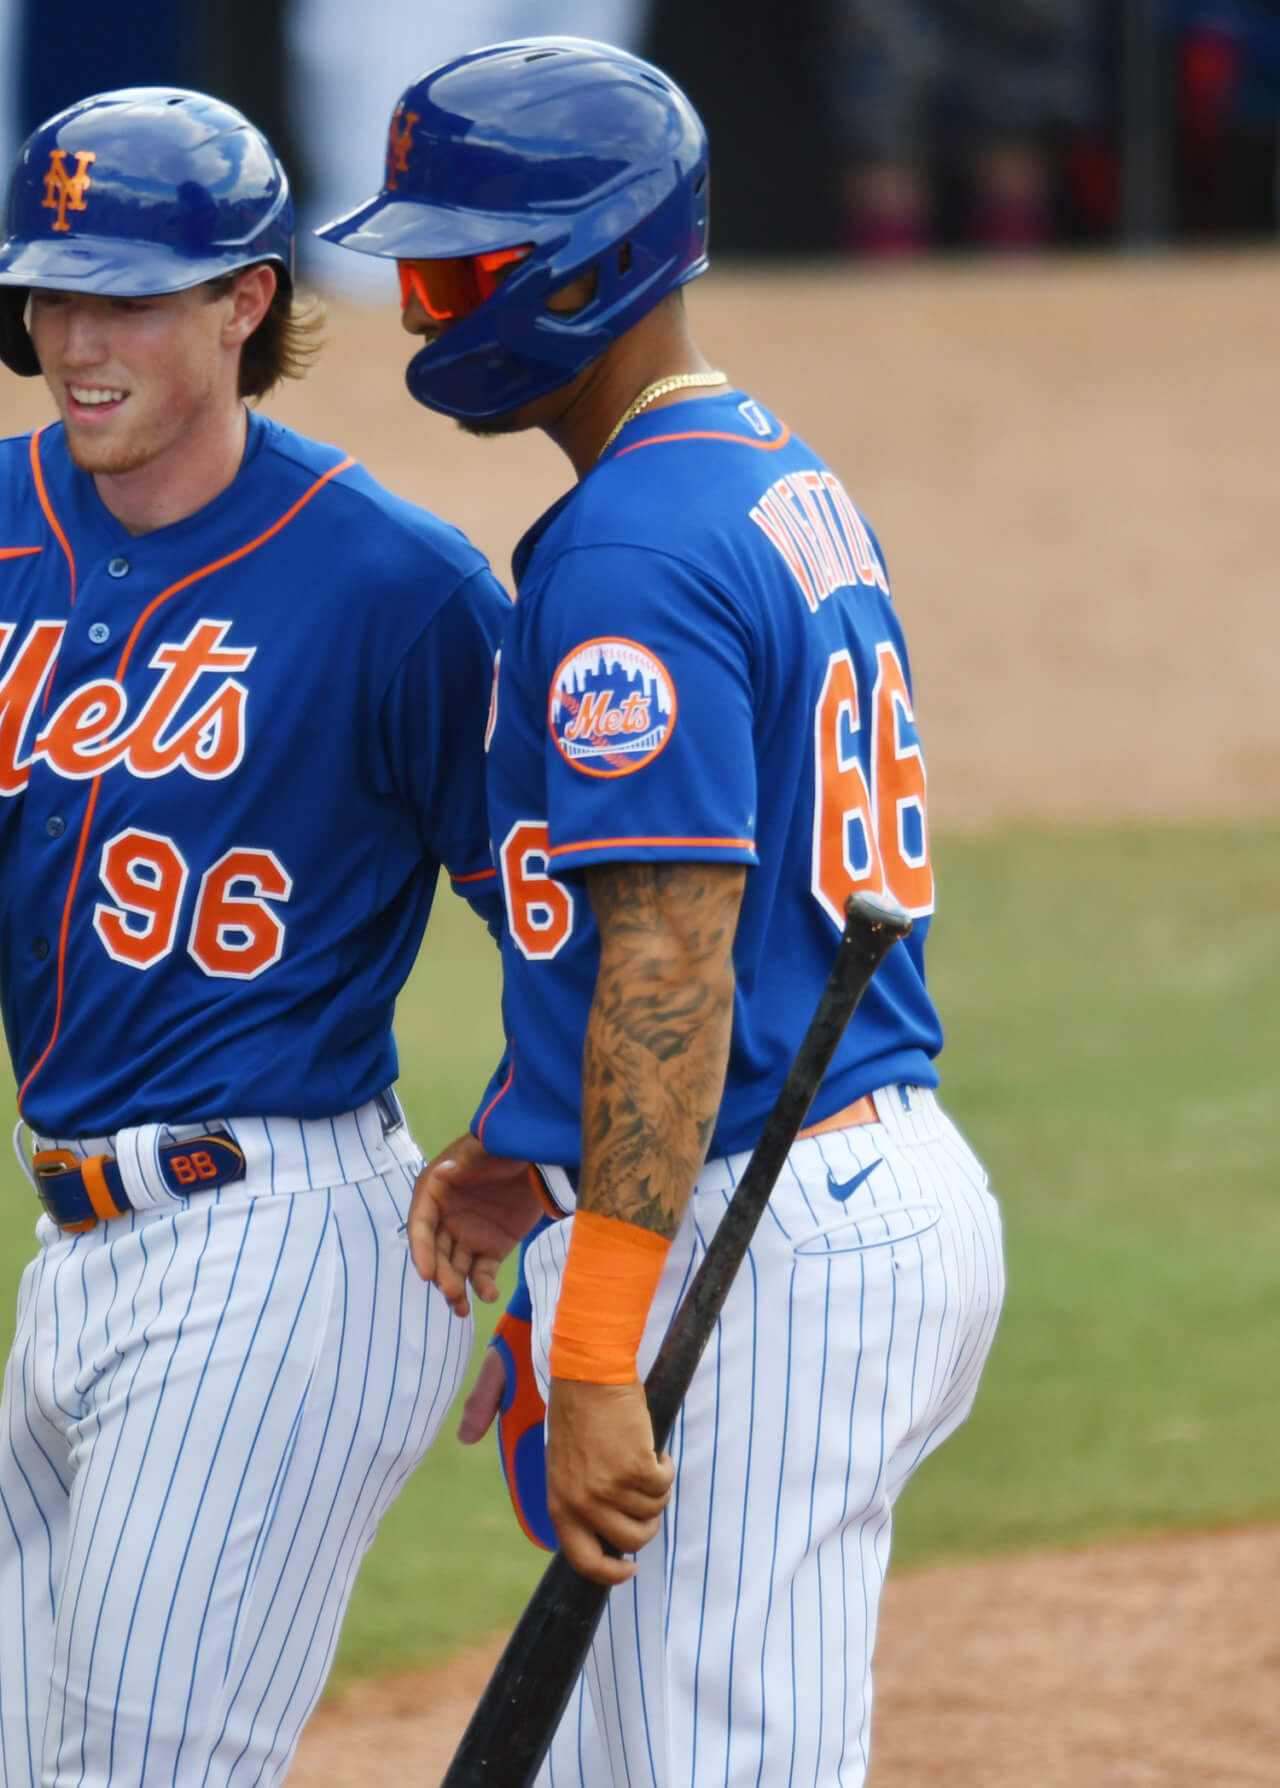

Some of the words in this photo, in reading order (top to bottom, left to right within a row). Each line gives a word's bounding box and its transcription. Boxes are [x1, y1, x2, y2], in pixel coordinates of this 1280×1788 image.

[41, 149, 97, 232] NY
[565, 690, 651, 740] Mets
[811, 640, 935, 933] 66
[92, 827, 293, 980] 96
